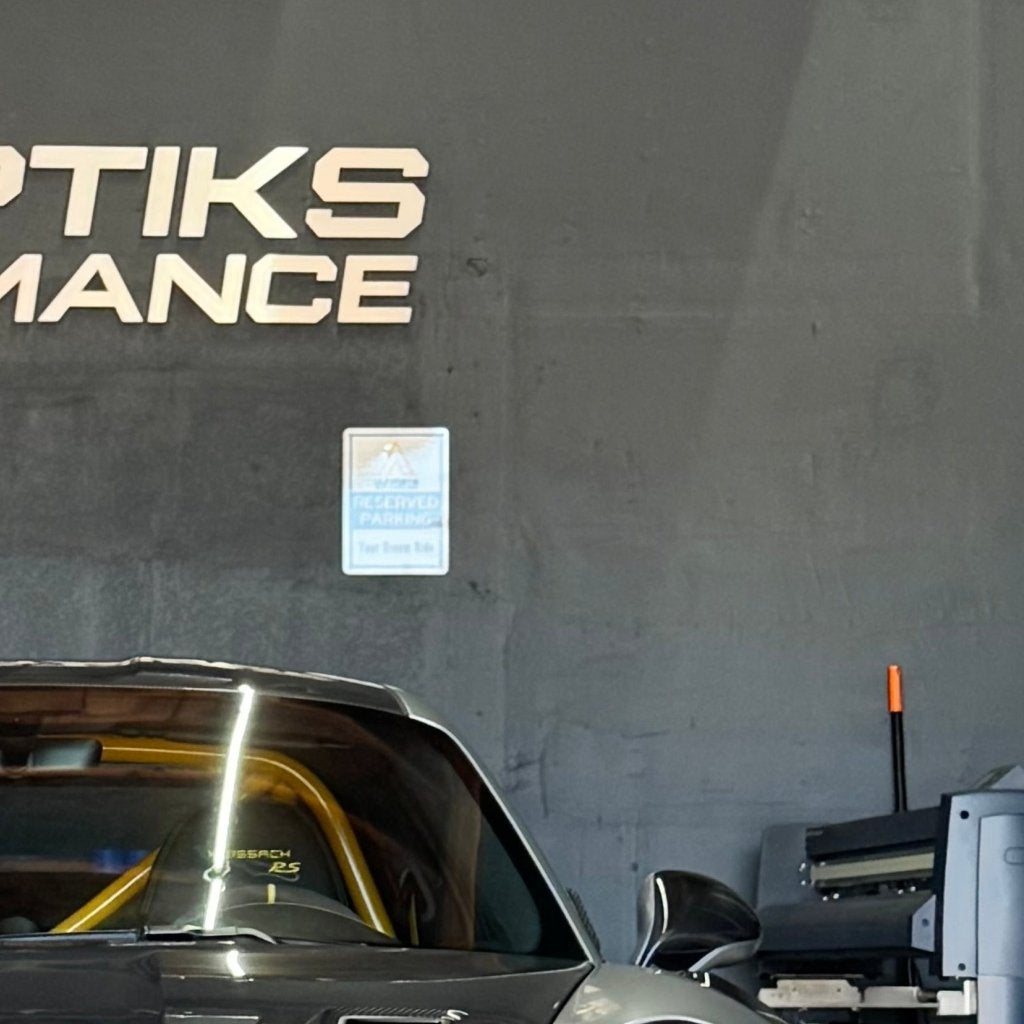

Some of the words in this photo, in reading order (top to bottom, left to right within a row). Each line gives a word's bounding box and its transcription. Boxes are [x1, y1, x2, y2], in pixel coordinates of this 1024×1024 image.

[352, 495, 439, 509] RESERVED
[360, 511, 432, 526] PARKING
[207, 849, 291, 859] ISSACH
[268, 861, 302, 874] RS
